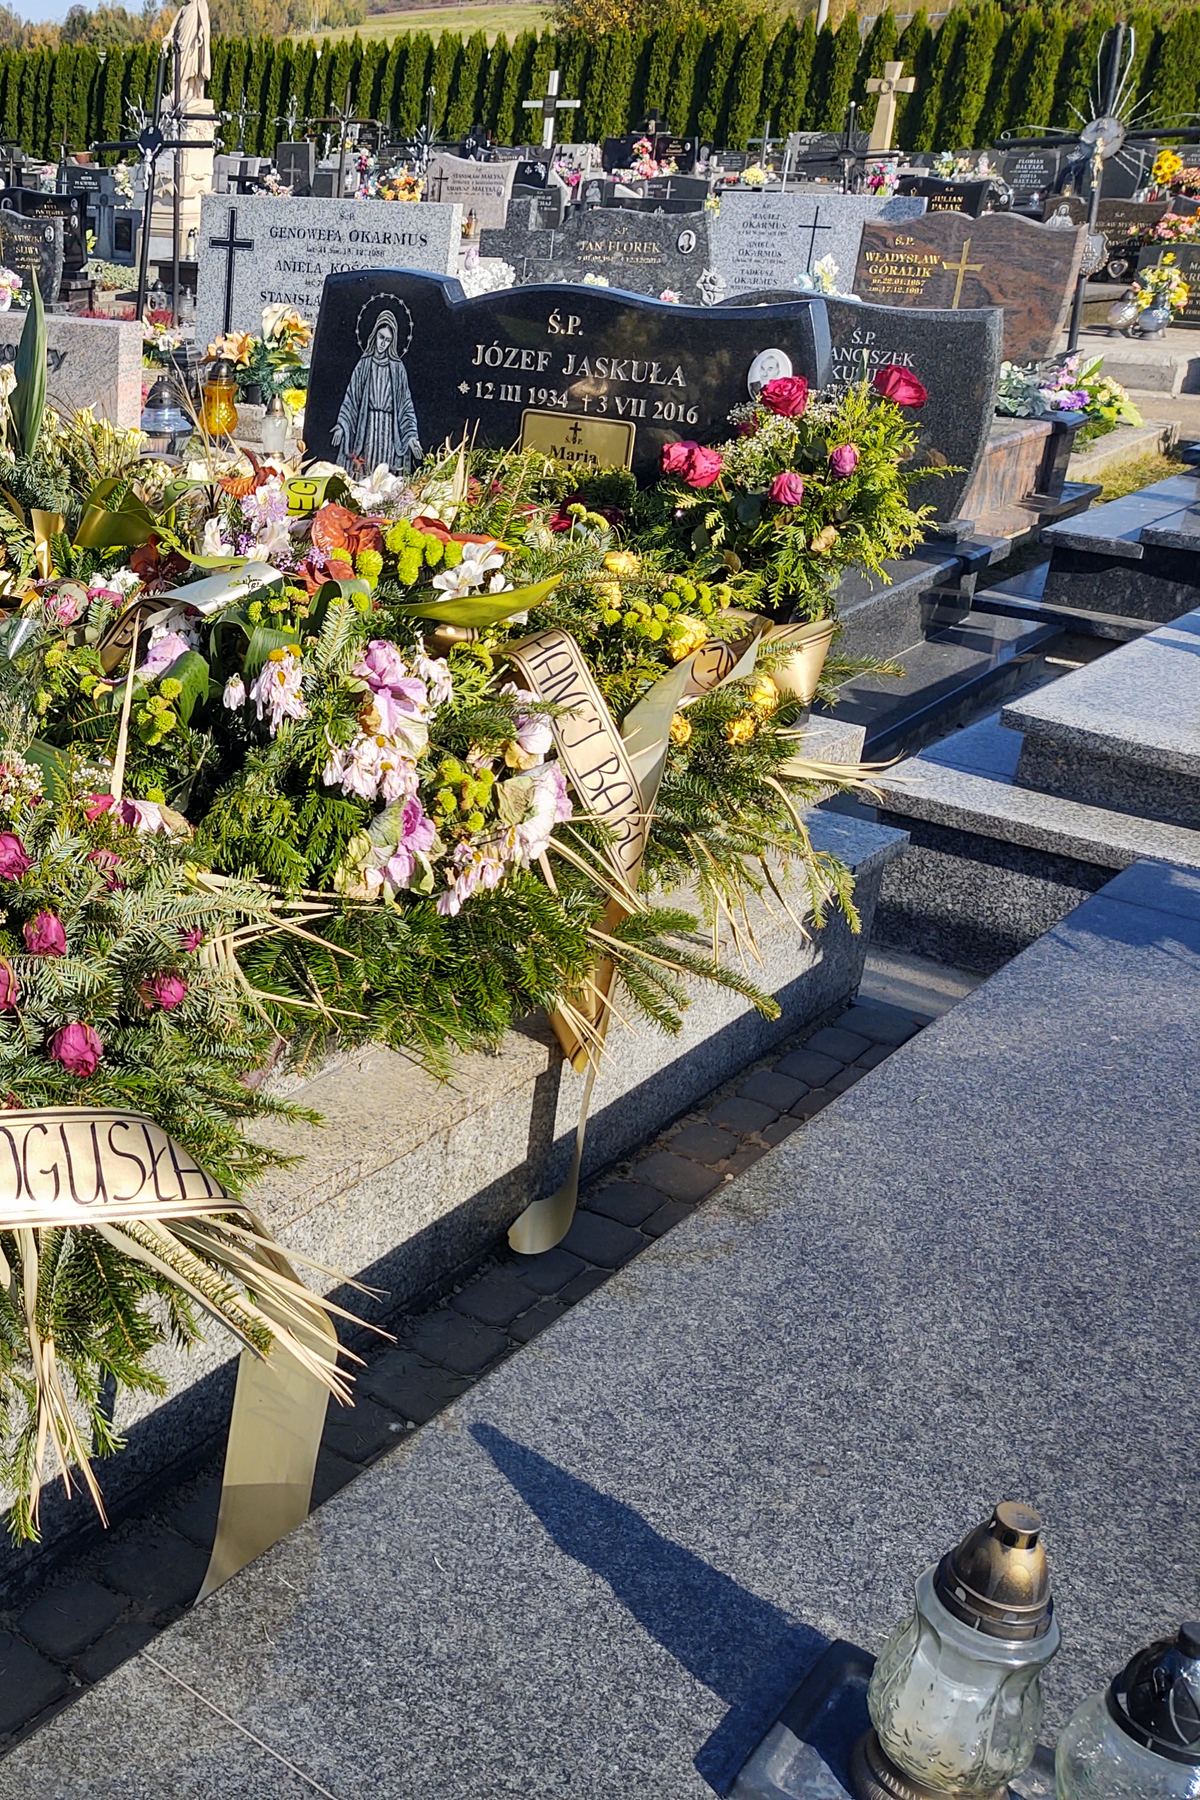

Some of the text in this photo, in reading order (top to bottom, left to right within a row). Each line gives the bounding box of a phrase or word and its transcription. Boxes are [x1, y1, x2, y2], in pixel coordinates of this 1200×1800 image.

[931, 195, 964, 203] JULIAN
[742, 221, 787, 230] OKARMUS
[269, 226, 429, 248] GENOWEFA OKARMUS
[579, 241, 662, 254] JAN FLOREK
[738, 249, 783, 258] OKARMUS
[865, 251, 941, 265] WŁADYSŁAW
[275, 260, 323, 275] ANIELA
[869, 263, 932, 278] GÓRALIK
[734, 277, 779, 286] OKARMUS
[260, 291, 321, 307] STANISŁA
[547, 308, 584, 337] Ś.P.
[851, 327, 876, 346] Ś.P.
[471, 340, 688, 388] JÓZEF JASKUŁA
[475, 381, 699, 426] 12 III 1934 3 VII 2016
[549, 444, 598, 465] Maria
